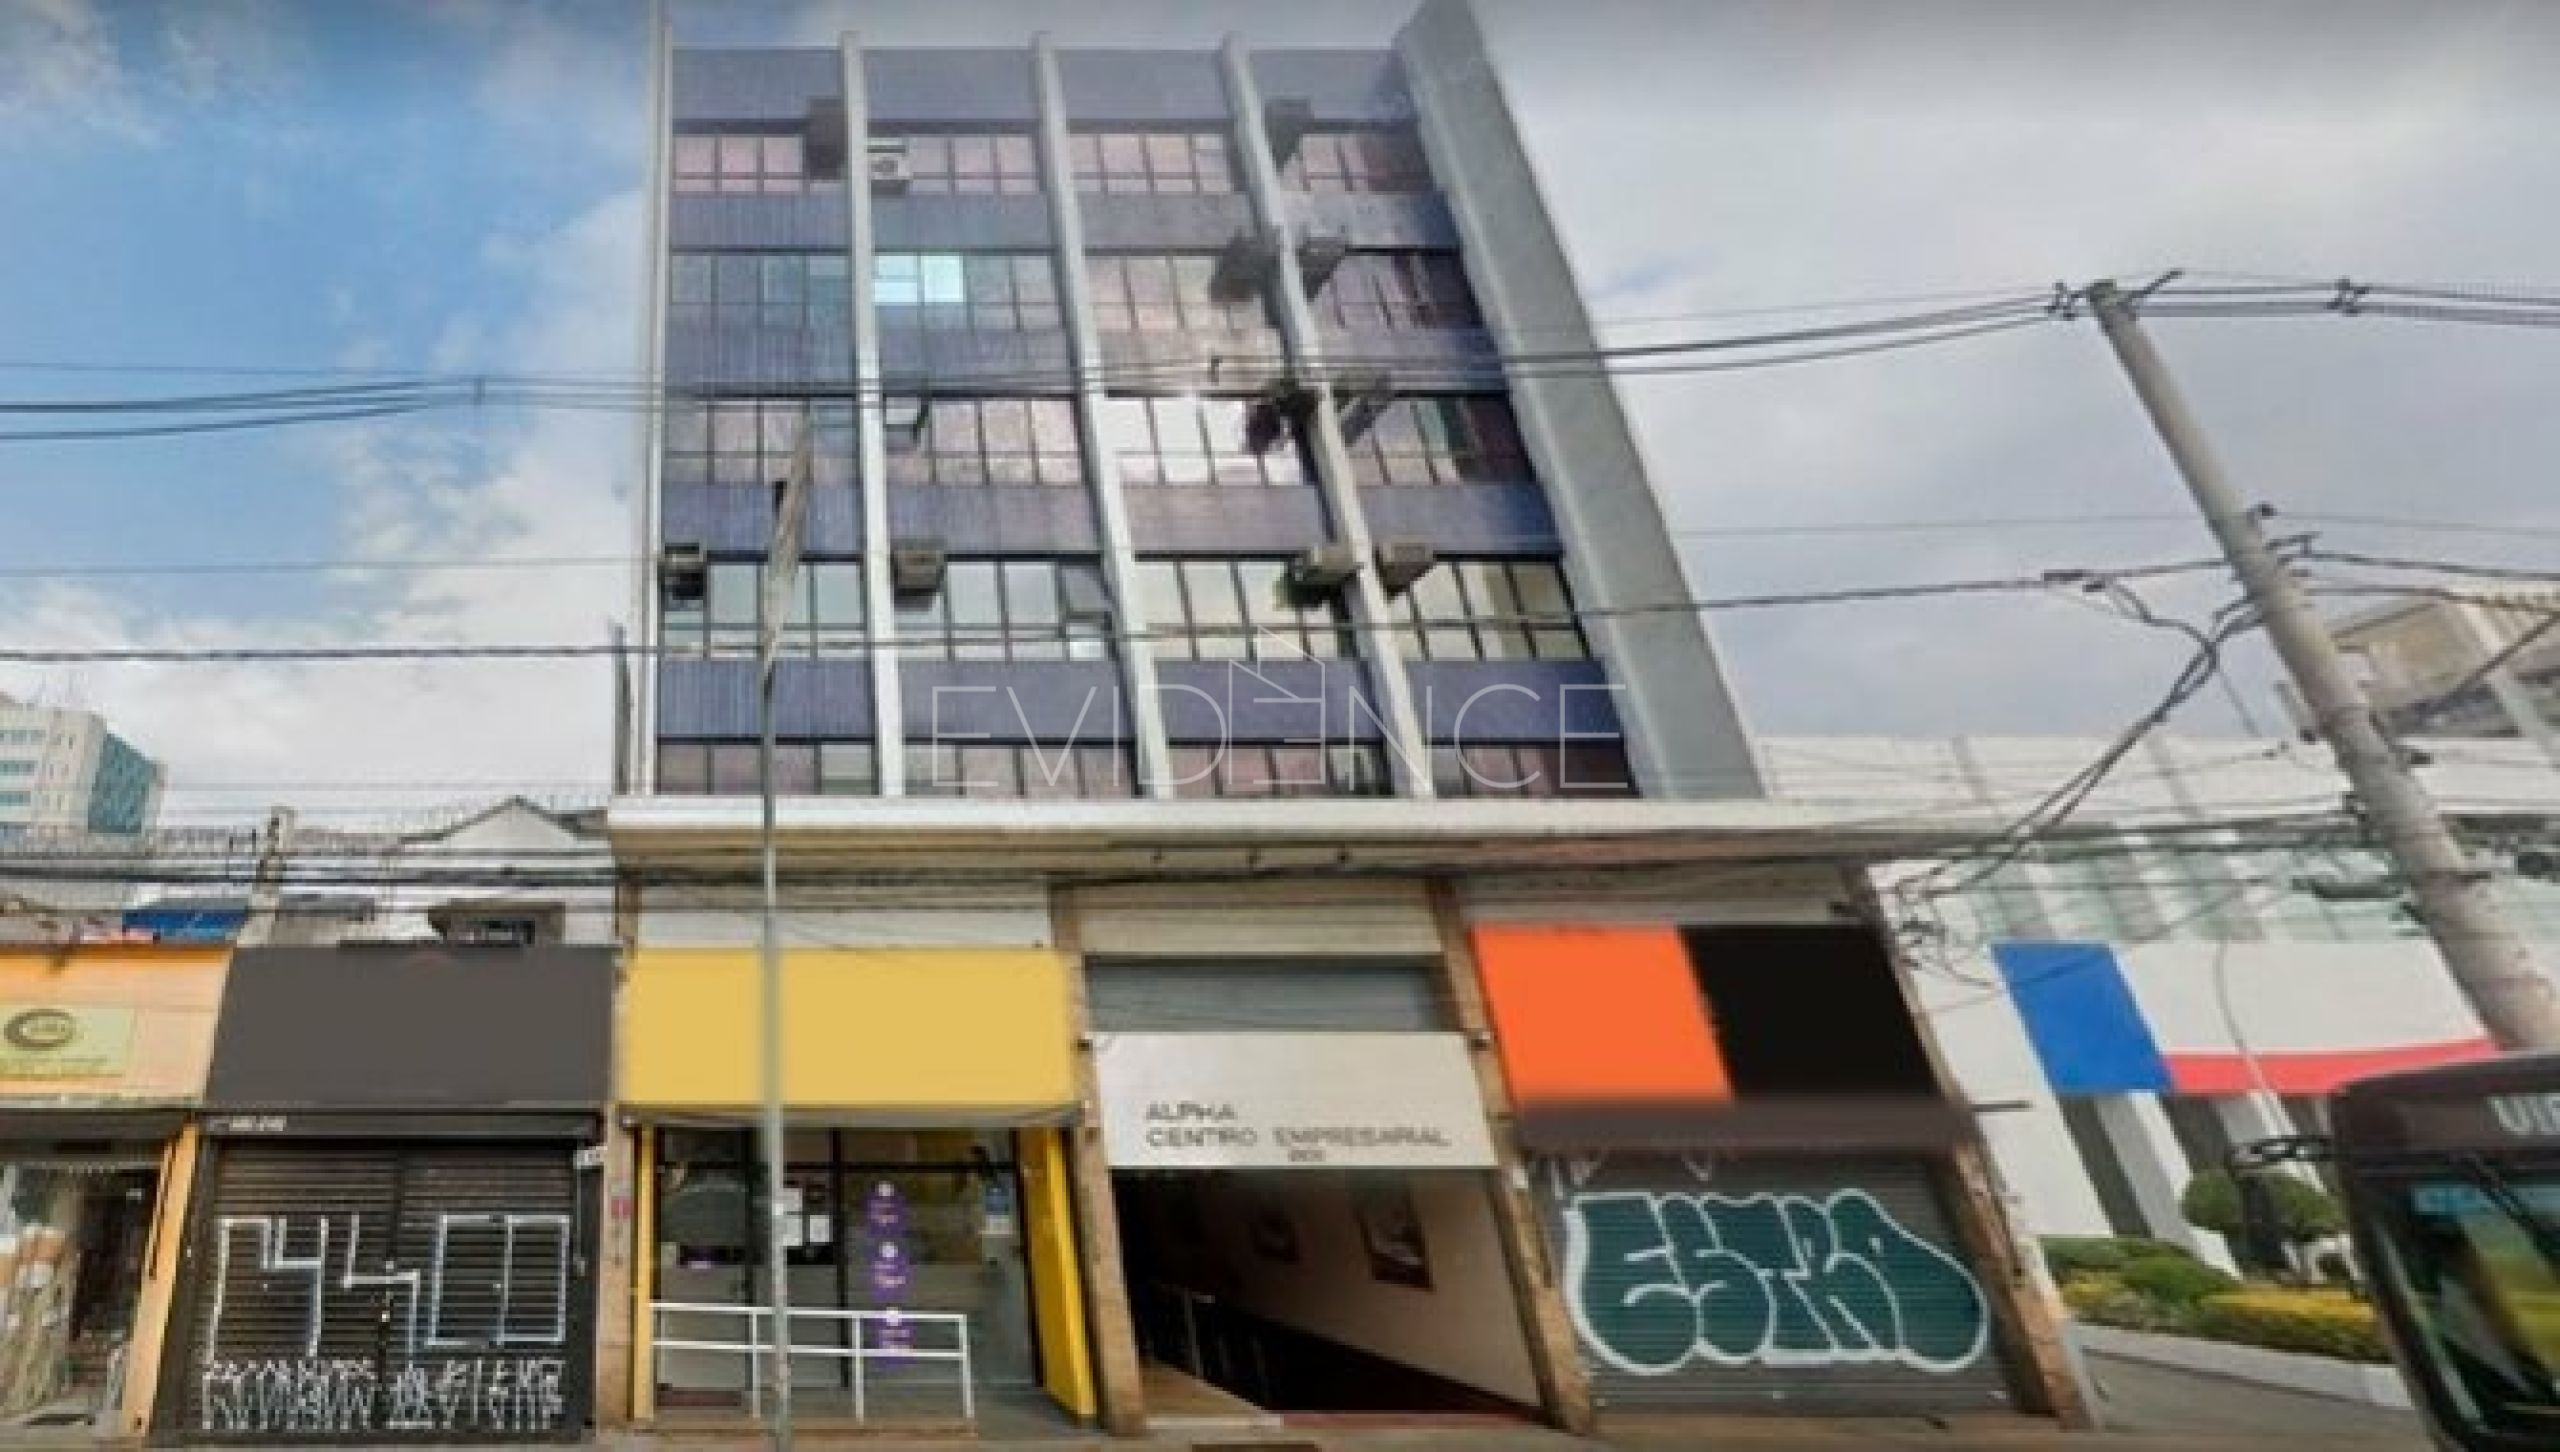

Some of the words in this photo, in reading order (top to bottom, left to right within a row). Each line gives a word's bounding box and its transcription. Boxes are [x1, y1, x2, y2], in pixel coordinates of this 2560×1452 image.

[1145, 1102, 1237, 1121] ALPHA
[1146, 1127, 1257, 1147] CENTRO
[1273, 1127, 1451, 1147] EMPRESARIAL
